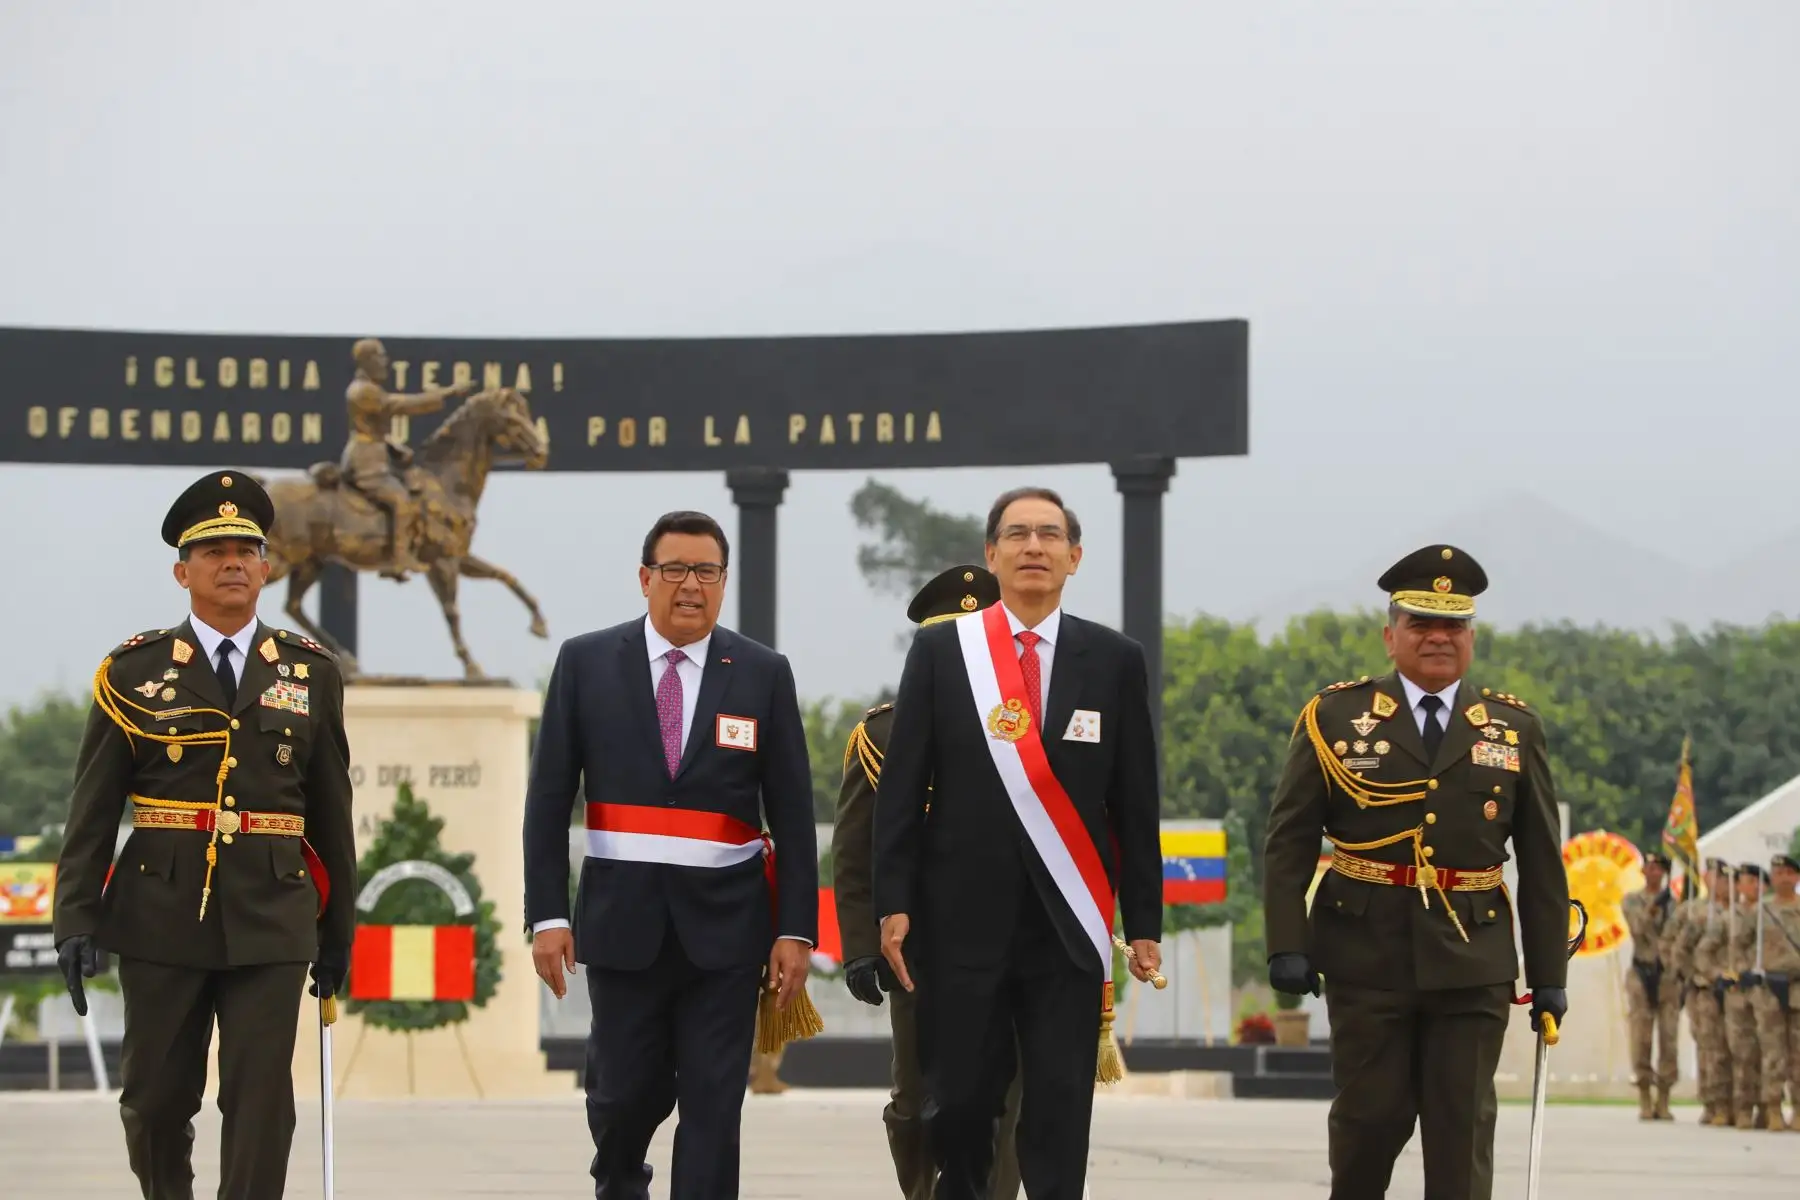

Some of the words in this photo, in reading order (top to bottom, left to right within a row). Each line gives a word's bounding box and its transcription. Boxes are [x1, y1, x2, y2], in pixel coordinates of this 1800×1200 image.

[124, 356, 321, 391] ¡GLORIA
[391, 360, 564, 392] TERNA!
[27, 405, 323, 444] OFRENDARON
[587, 416, 667, 447] POR
[704, 415, 751, 446] LA
[789, 411, 942, 444] PATRIA
[428, 759, 481, 788] PERÚ
